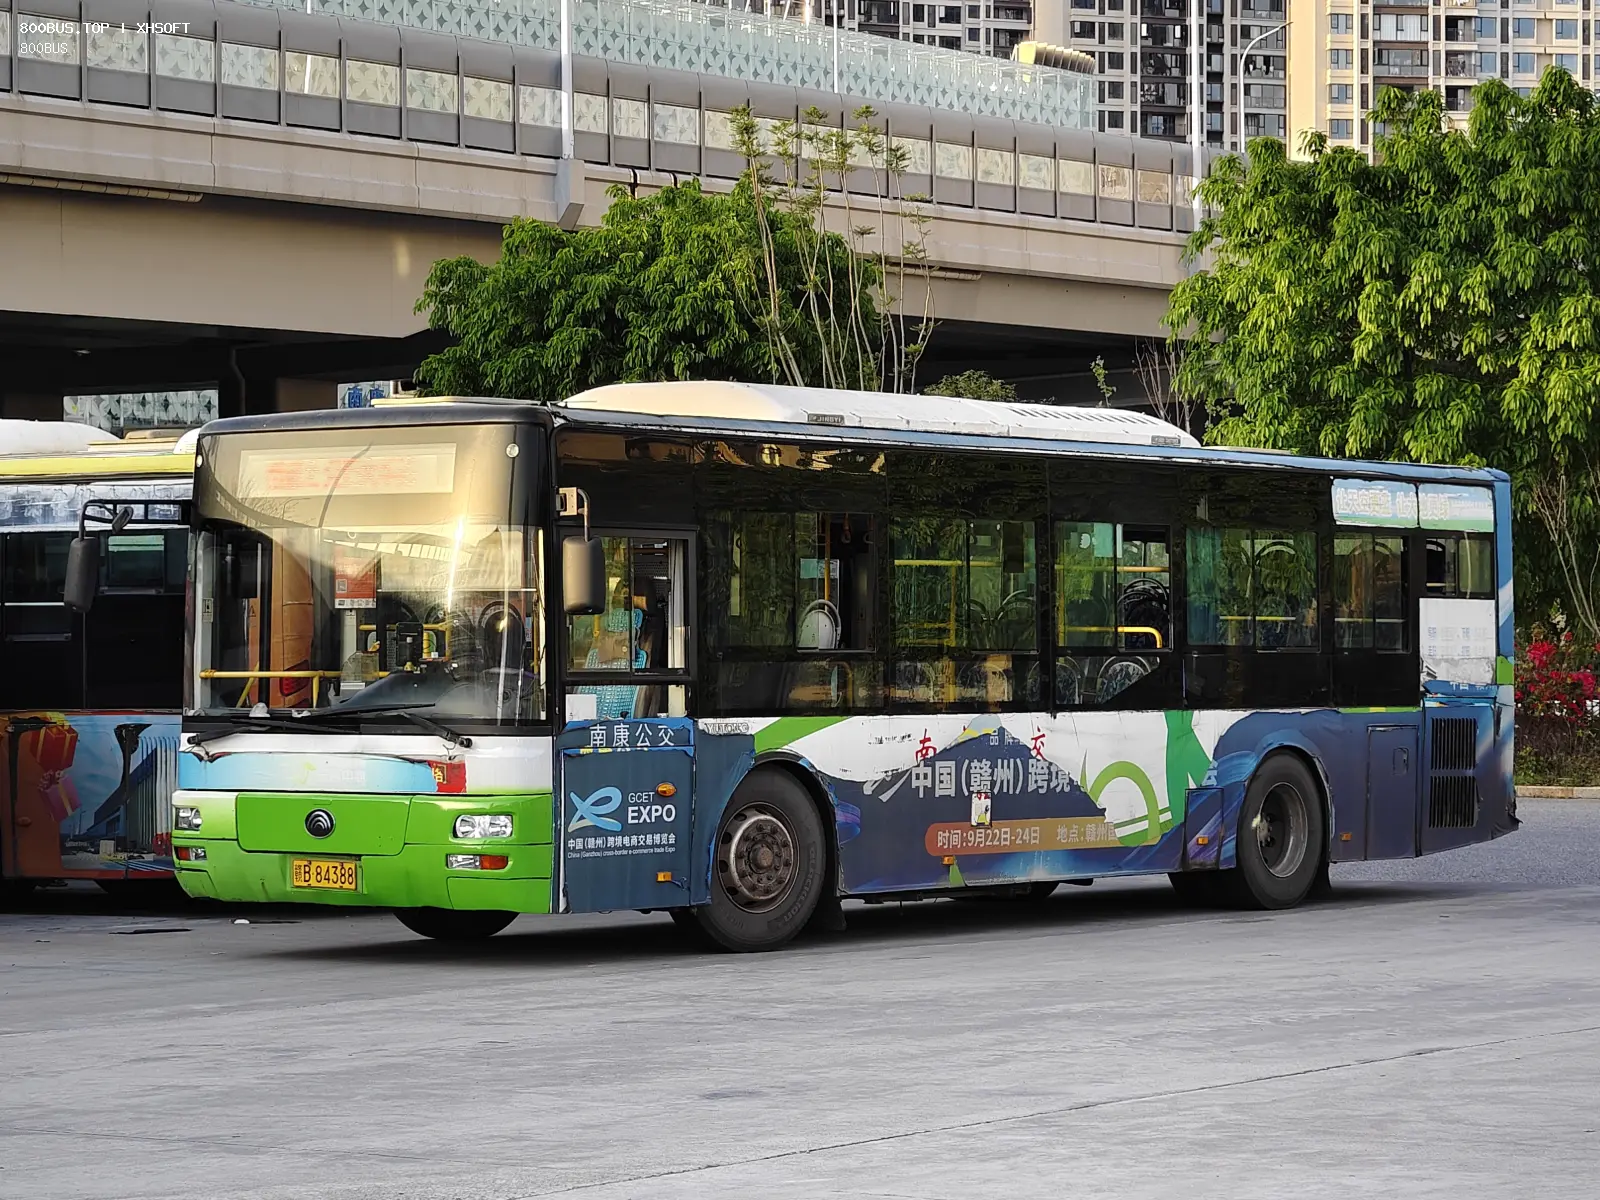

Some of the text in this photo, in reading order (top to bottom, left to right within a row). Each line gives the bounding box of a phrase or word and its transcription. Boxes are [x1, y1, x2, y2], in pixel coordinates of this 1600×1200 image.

[589, 723, 675, 747] 南康公交
[628, 792, 655, 803] GCET
[627, 804, 676, 824] EXPO
